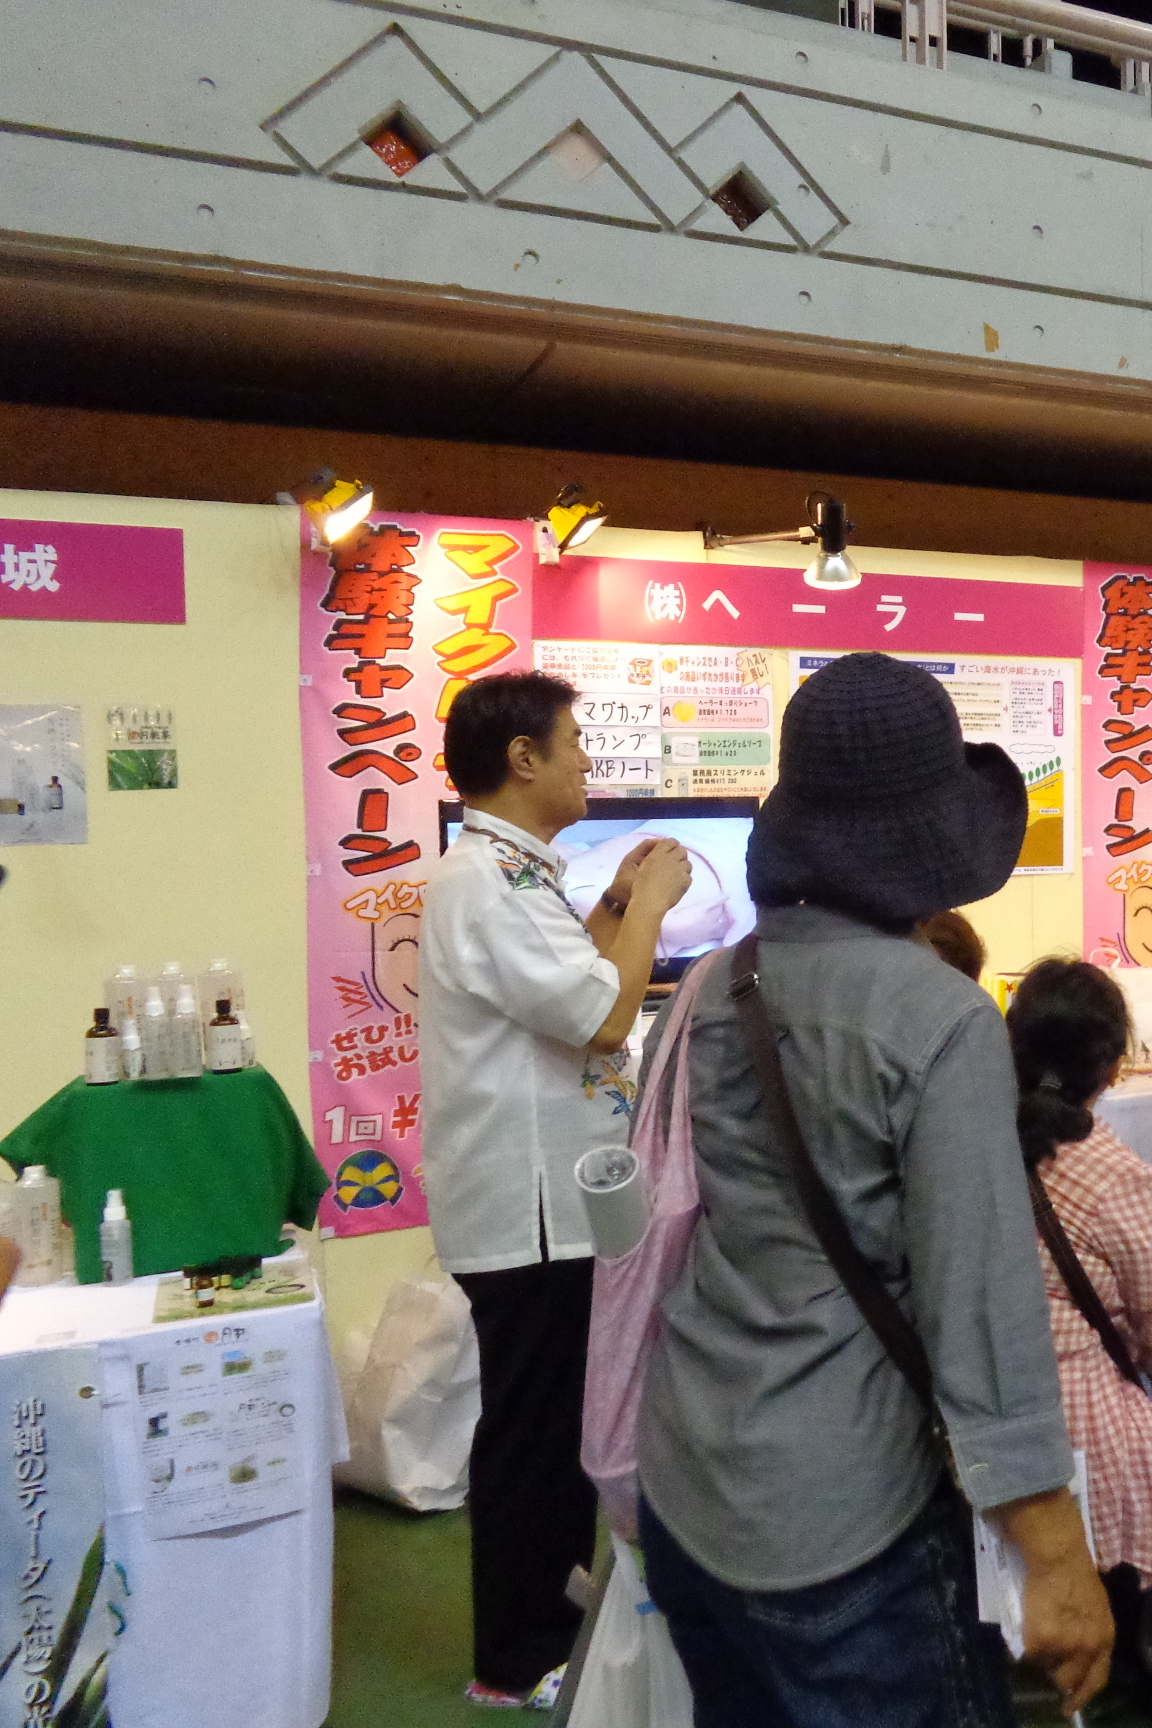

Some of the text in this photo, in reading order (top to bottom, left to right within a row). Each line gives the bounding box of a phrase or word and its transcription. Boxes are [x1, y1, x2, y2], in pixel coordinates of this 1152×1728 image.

[0, 544, 60, 592] 城
[583, 701, 653, 724] マグカップ
[662, 706, 671, 717] A
[585, 732, 647, 751] トランプ
[663, 745, 672, 755] B
[664, 779, 673, 789] C
[330, 1012, 414, 1053] ぜひ!!
[324, 1105, 384, 1146] 1回
